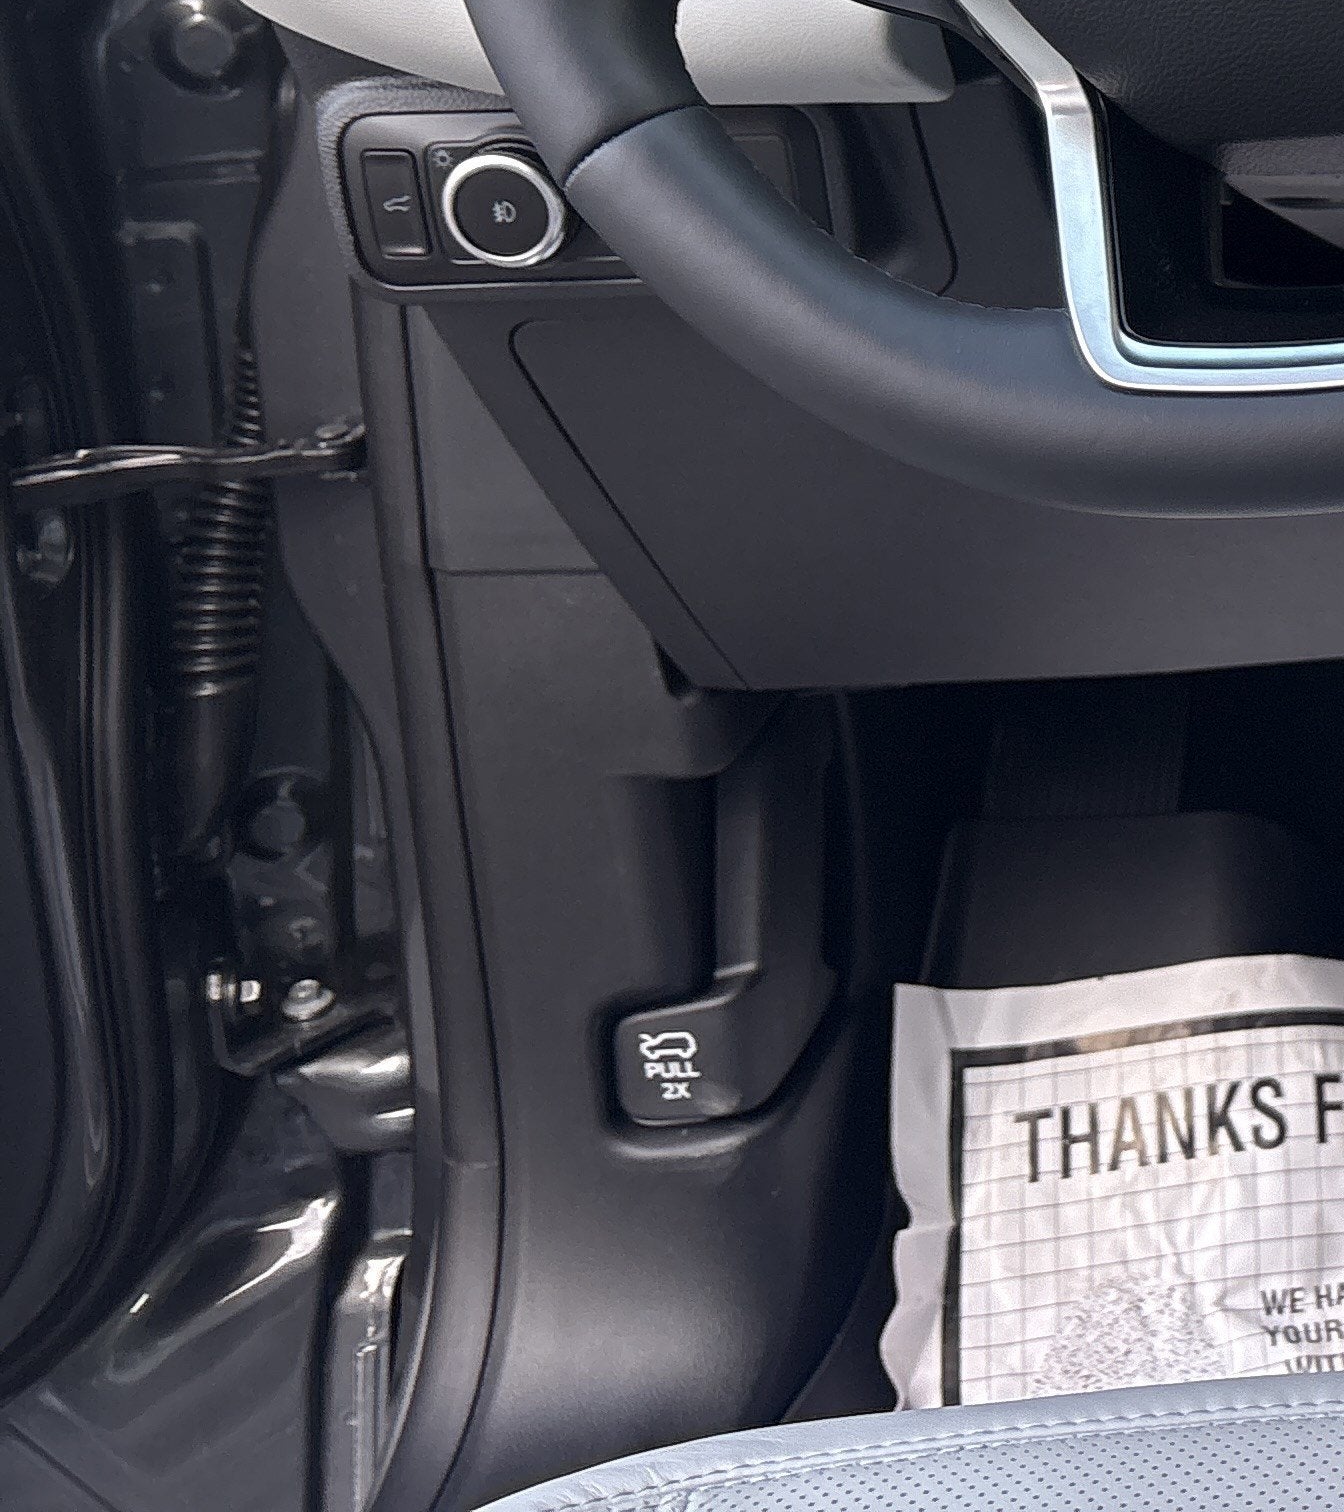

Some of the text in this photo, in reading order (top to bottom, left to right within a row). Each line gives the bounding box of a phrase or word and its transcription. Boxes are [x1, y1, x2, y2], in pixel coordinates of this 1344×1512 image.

[644, 1061, 702, 1079] PULL
[660, 1082, 692, 1101] 2X
[1014, 1075, 1288, 1183] THANKS
[1260, 1287, 1307, 1316] WE
[1262, 1317, 1344, 1347] YOUR
